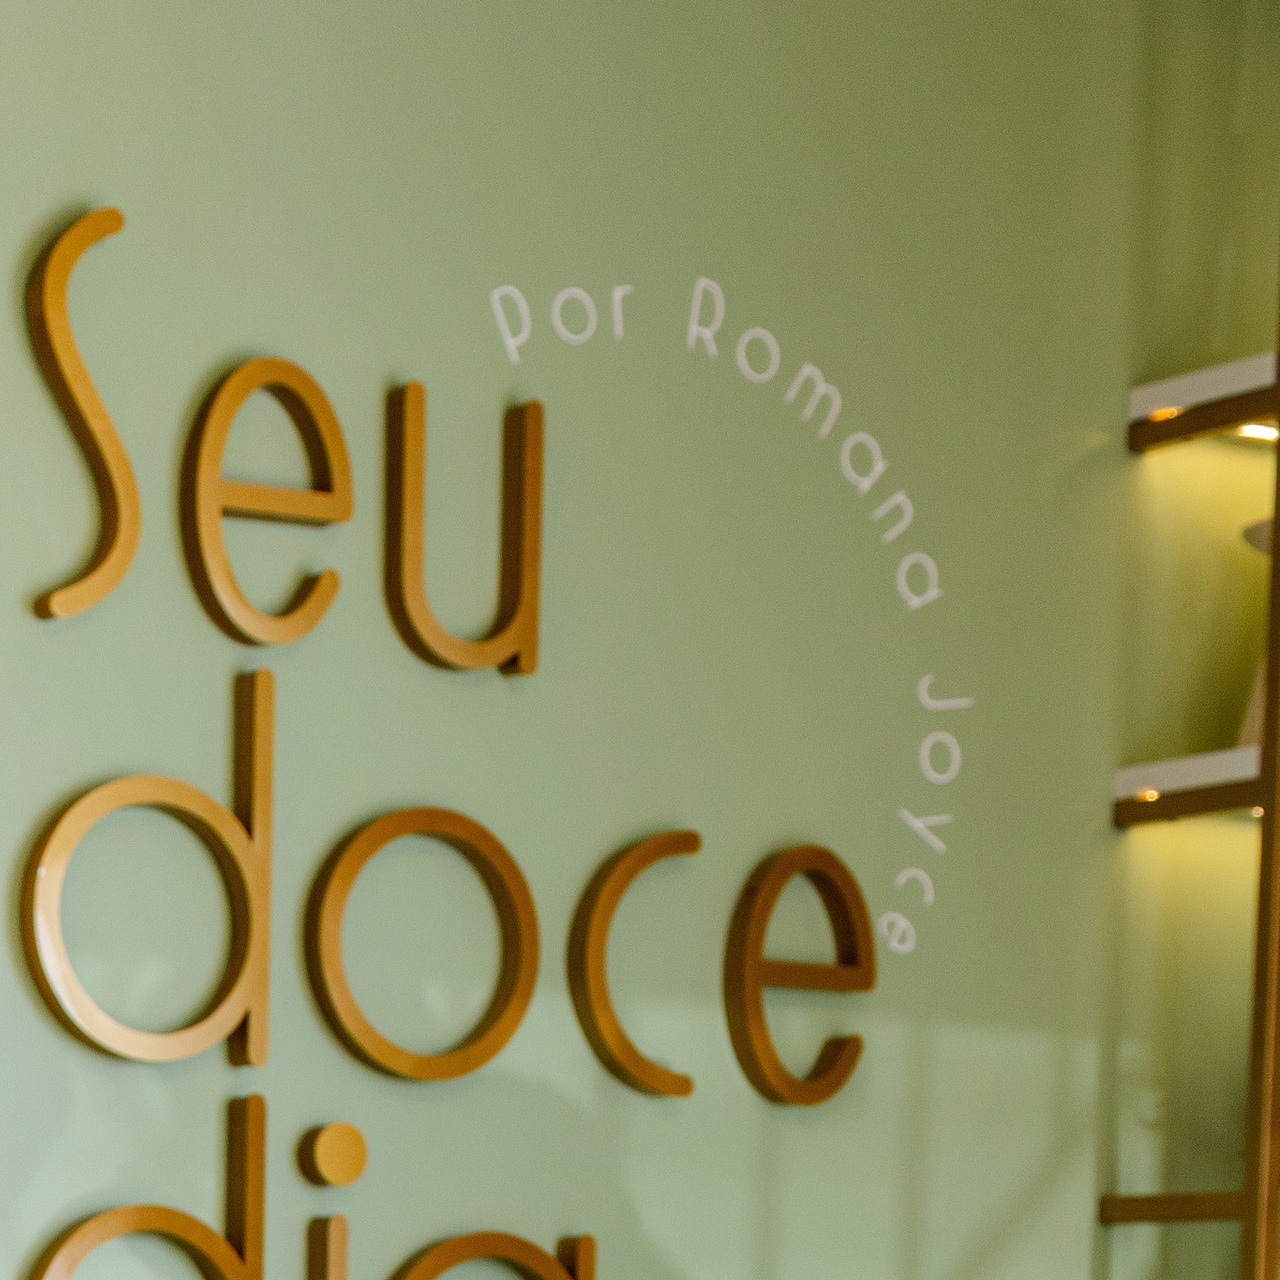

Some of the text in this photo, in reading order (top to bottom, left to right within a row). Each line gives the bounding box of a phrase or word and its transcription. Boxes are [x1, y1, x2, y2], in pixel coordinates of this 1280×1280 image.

[24, 205, 544, 677] Seu
[488, 276, 975, 954] por Romana Joyce
[20, 667, 877, 1106] doce
